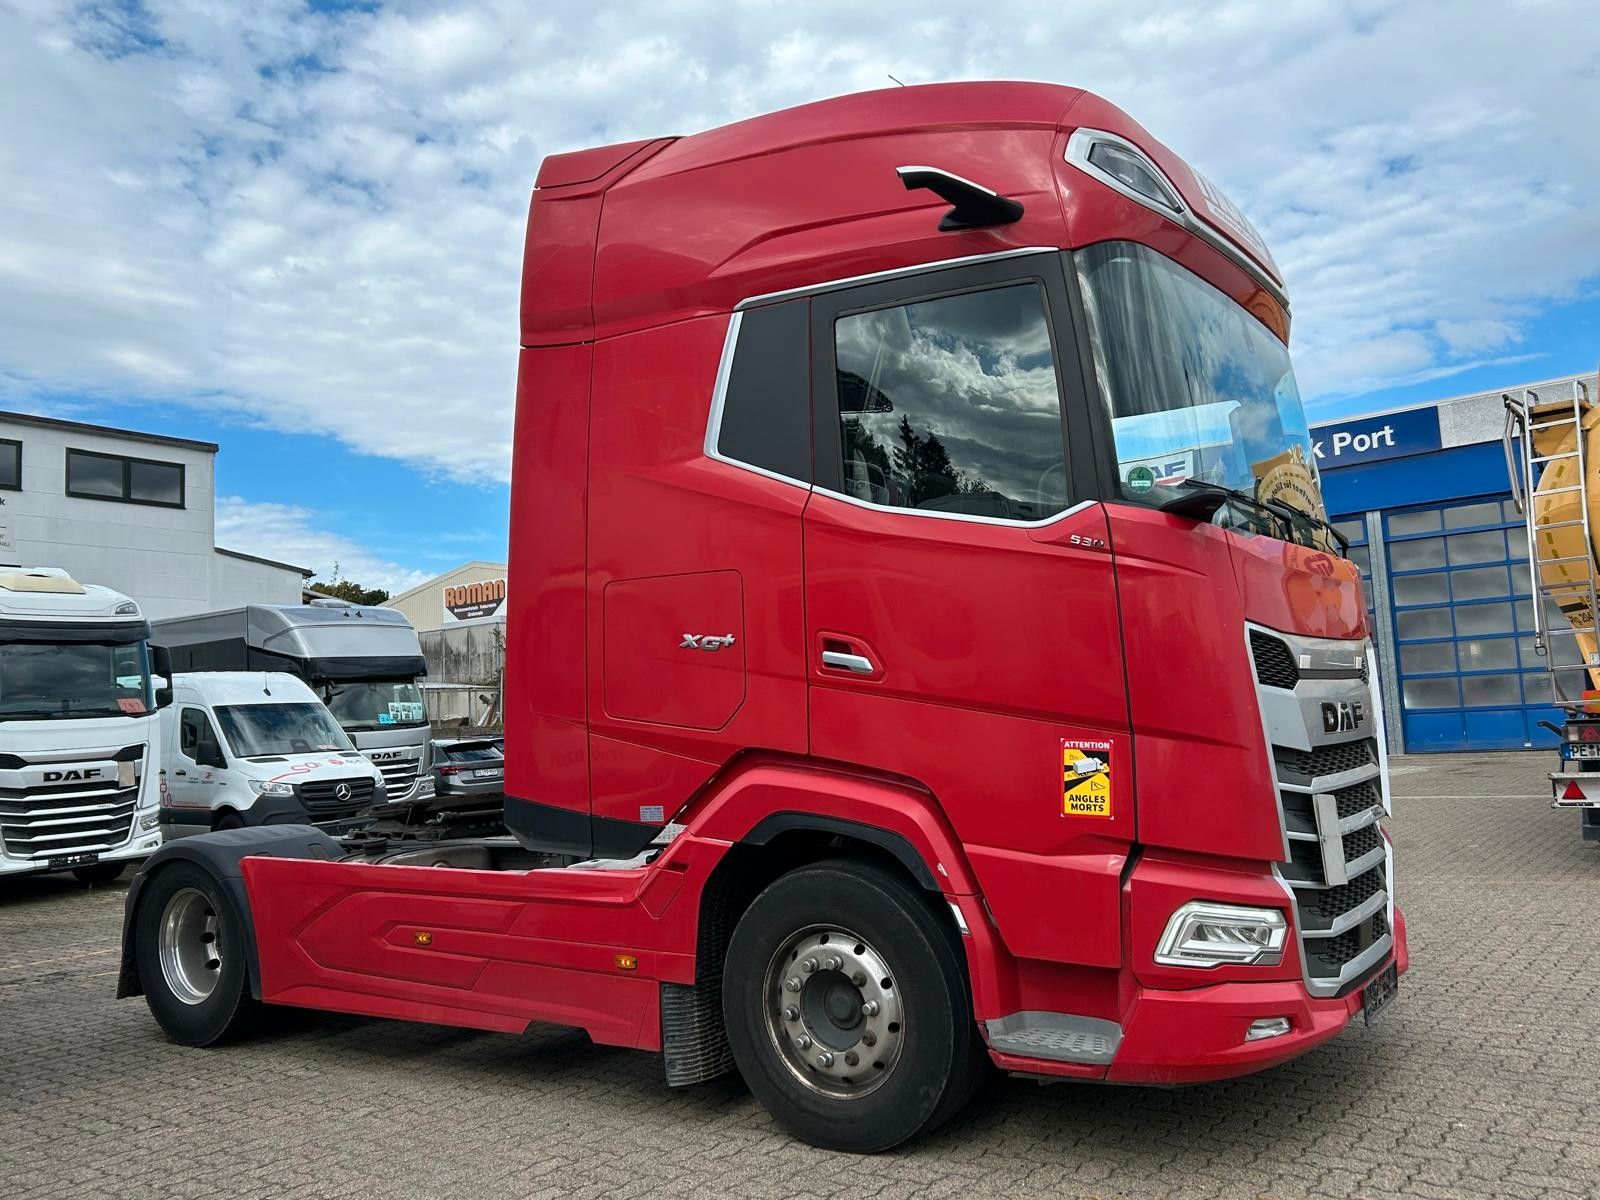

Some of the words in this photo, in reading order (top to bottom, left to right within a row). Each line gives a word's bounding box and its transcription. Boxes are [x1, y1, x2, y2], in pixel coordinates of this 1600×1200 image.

[1333, 425, 1395, 456] Port
[444, 579, 506, 608] ROMAN
[678, 632, 736, 651] XG+
[1320, 700, 1364, 733] DAF
[1063, 740, 1111, 750] ATTENTION
[371, 751, 403, 761] DAF
[43, 768, 102, 783] DAF
[1068, 794, 1107, 804] ANGLES
[1070, 803, 1105, 812] MORTS
